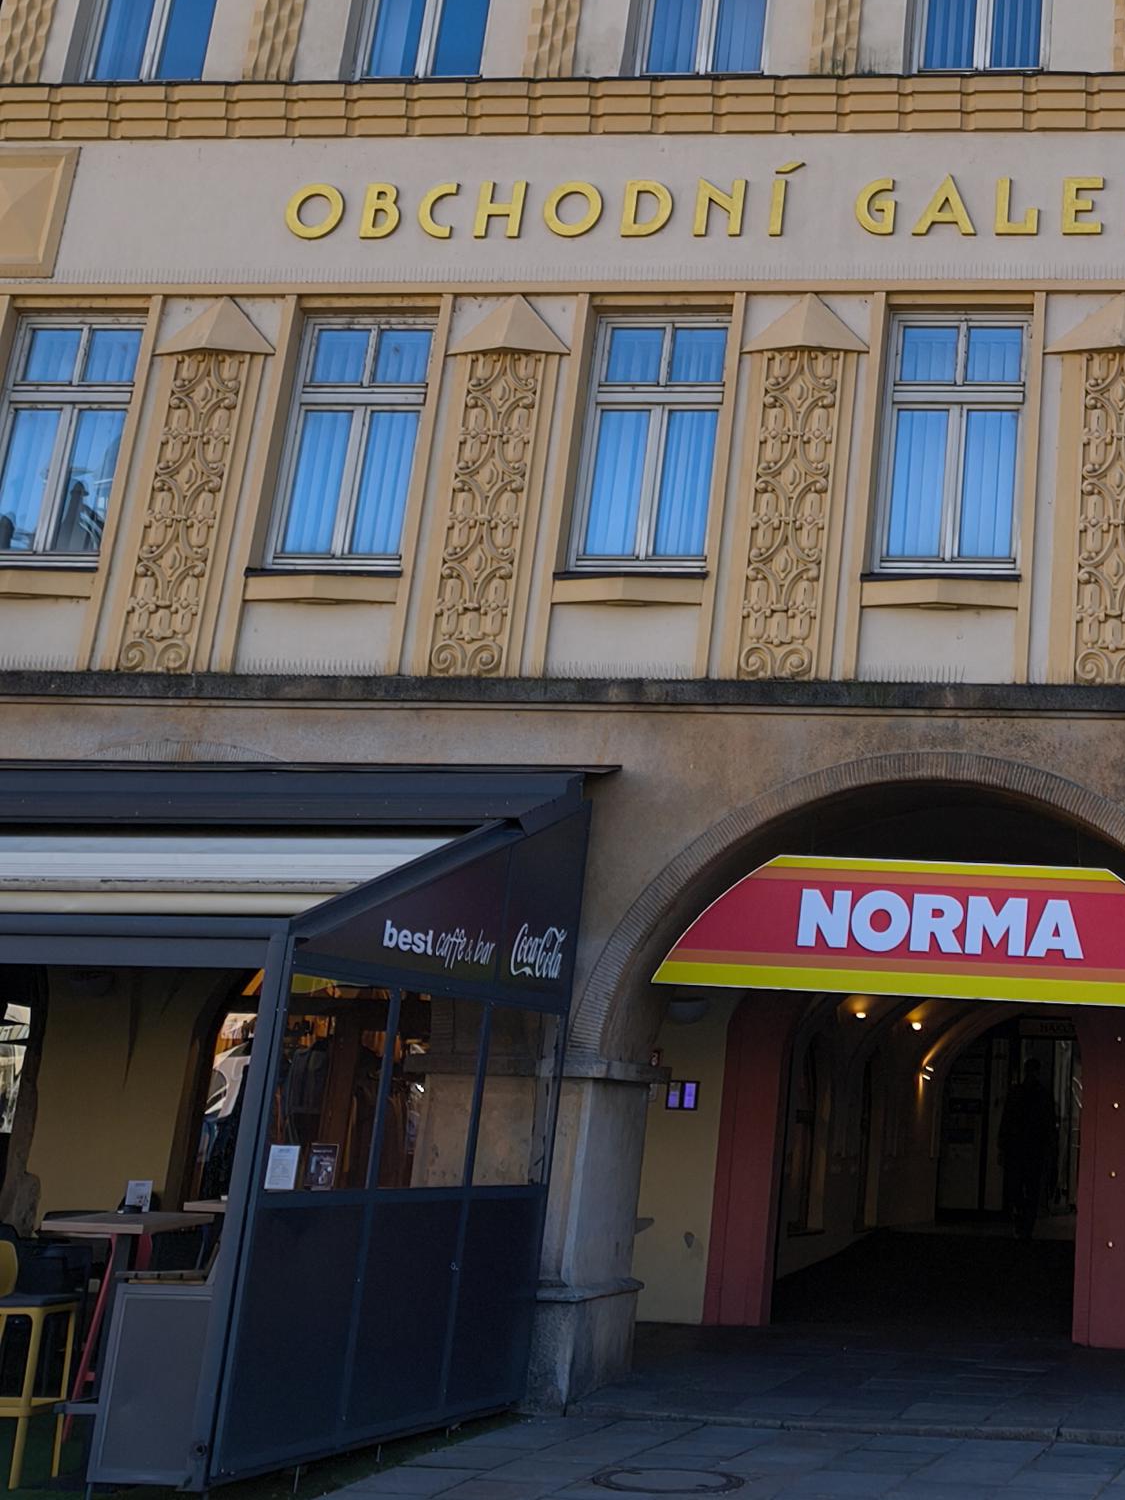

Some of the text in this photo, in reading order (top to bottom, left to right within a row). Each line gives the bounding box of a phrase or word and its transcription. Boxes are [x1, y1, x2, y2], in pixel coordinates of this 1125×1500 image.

[284, 161, 807, 240] OBCHODNÍ
[382, 919, 434, 956] best
[473, 929, 496, 966] bar
[796, 887, 1085, 961] NORMA
